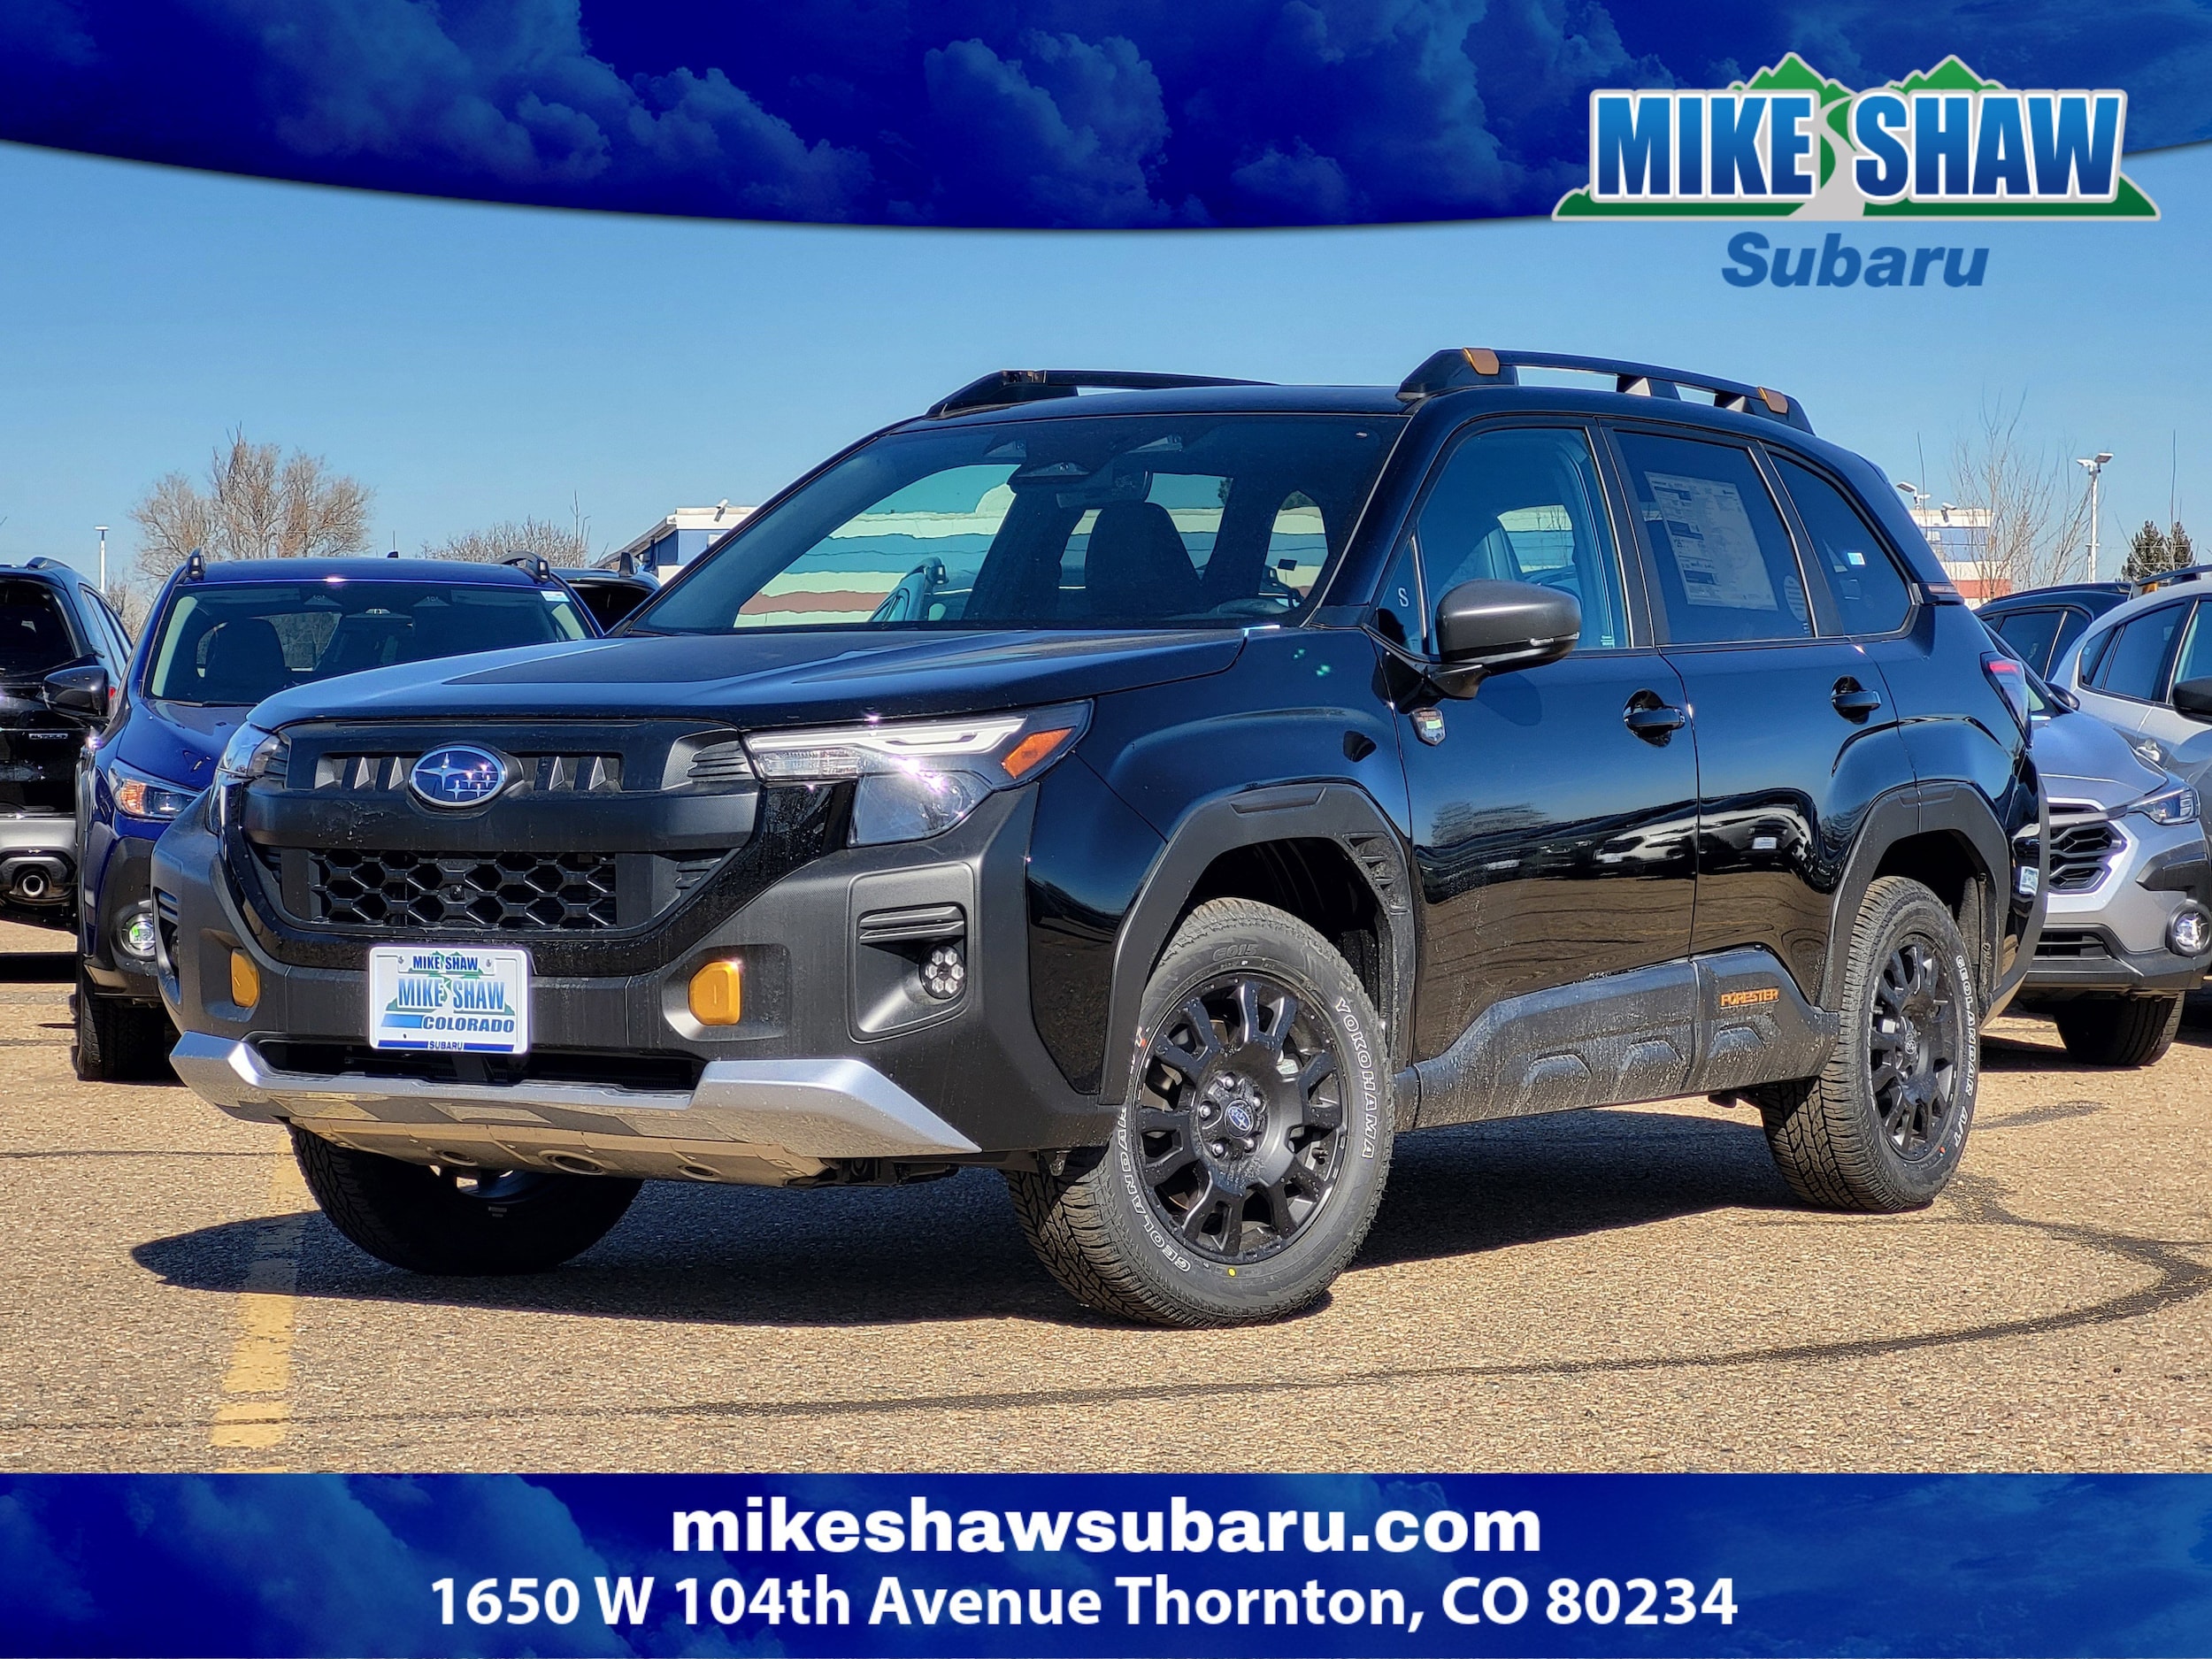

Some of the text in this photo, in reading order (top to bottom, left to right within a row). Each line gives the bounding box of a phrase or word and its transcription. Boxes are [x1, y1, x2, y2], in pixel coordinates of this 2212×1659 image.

[412, 956, 479, 971] MIKE SHAW
[398, 979, 505, 1010] MIKE SHAW
[1720, 988, 1780, 1007] FORESTER
[422, 1016, 515, 1033] COLORADO
[429, 1041, 463, 1050] SUBARU
[1335, 996, 1379, 1158] YOKOHAMA
